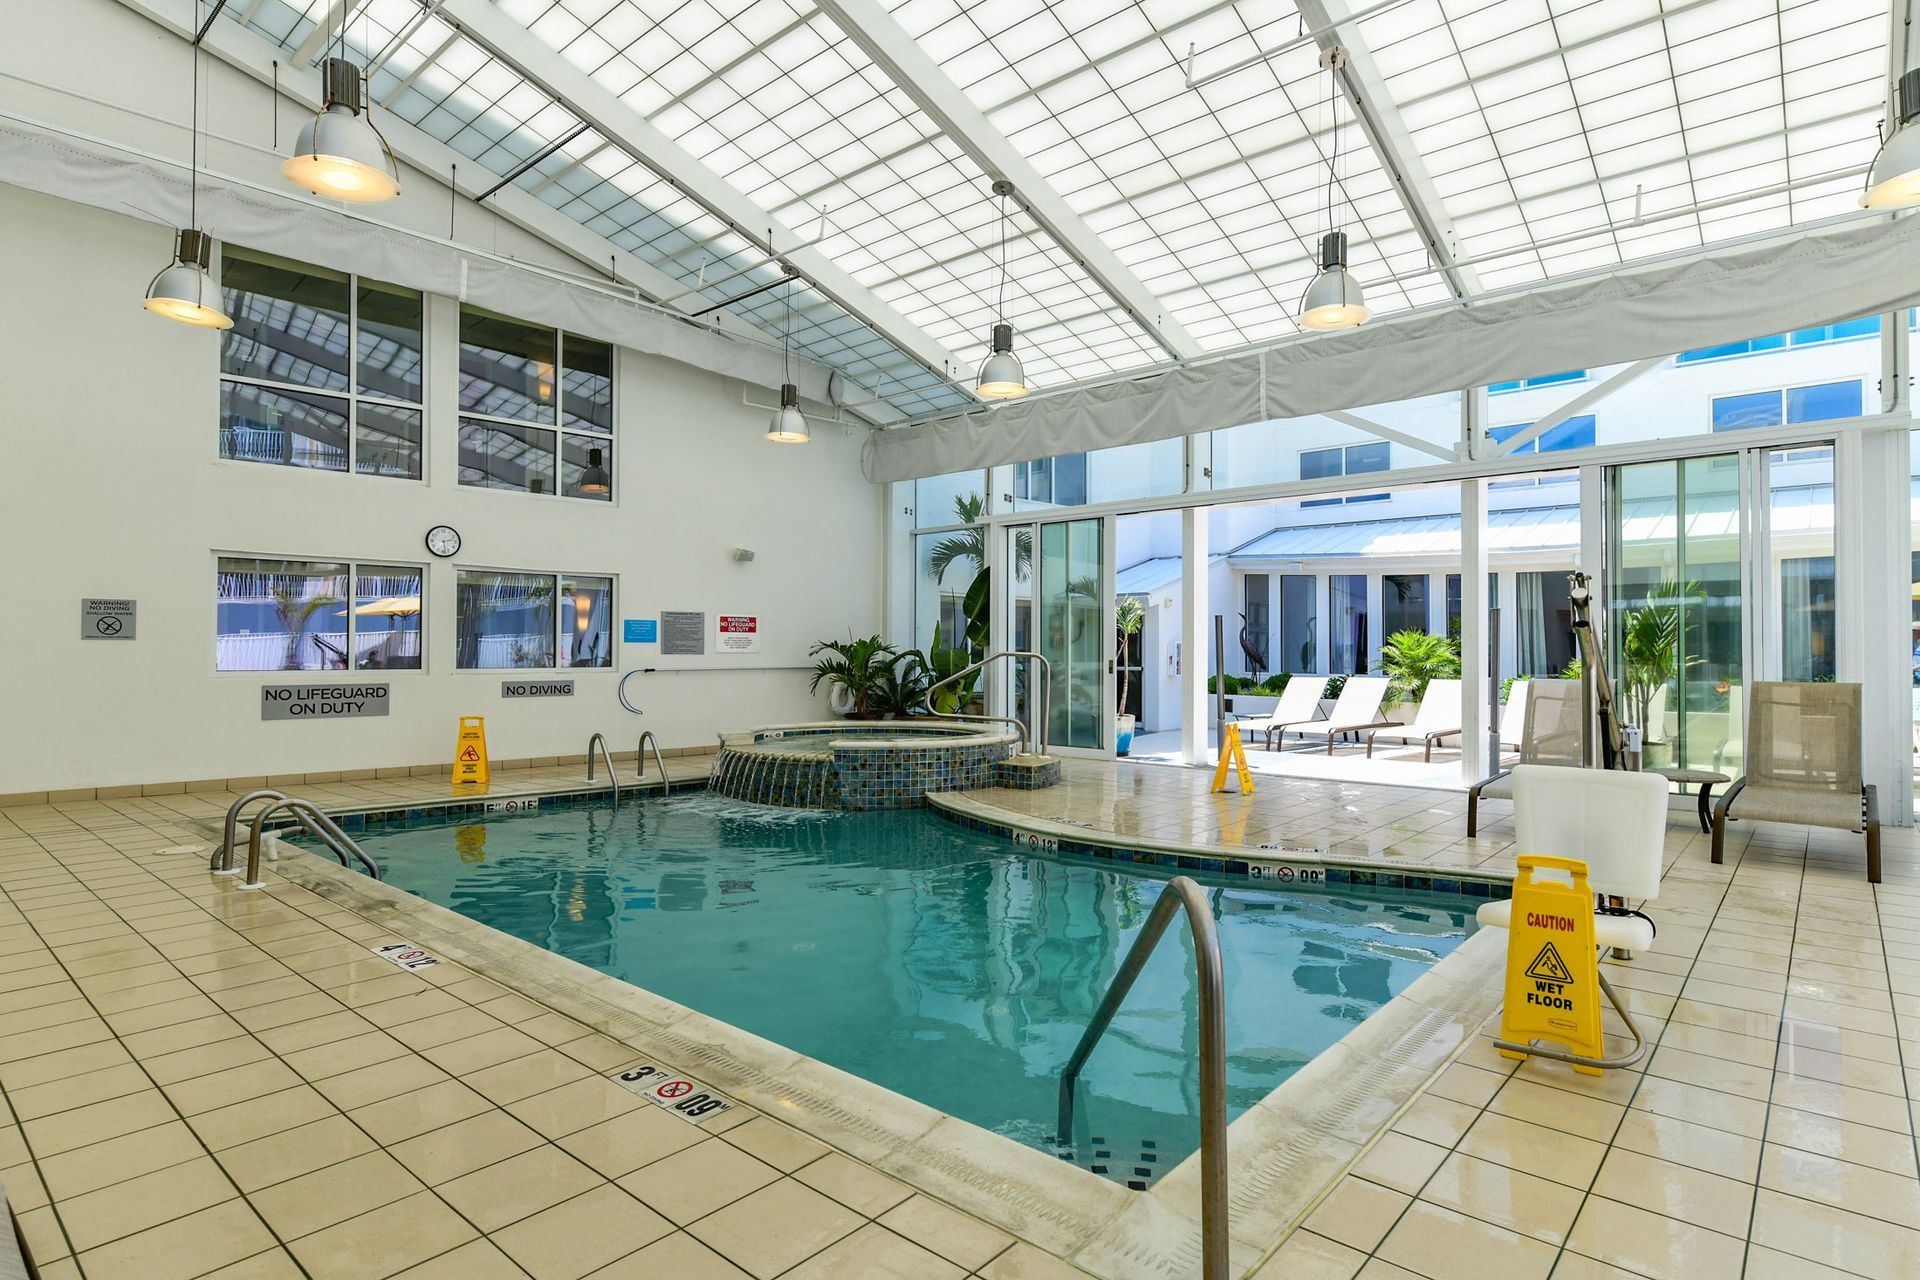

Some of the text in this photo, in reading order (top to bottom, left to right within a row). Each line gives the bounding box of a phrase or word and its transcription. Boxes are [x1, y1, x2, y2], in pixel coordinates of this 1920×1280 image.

[265, 687, 387, 701] NO LIFEGUARD
[506, 684, 571, 696] NO DIVING
[289, 701, 365, 715] ON DUTY
[1527, 912, 1575, 932] CAUTION
[380, 944, 407, 953] 4
[1535, 980, 1565, 995] WET
[1527, 992, 1573, 1011] FLOOR
[620, 1066, 670, 1082] 3 FT
